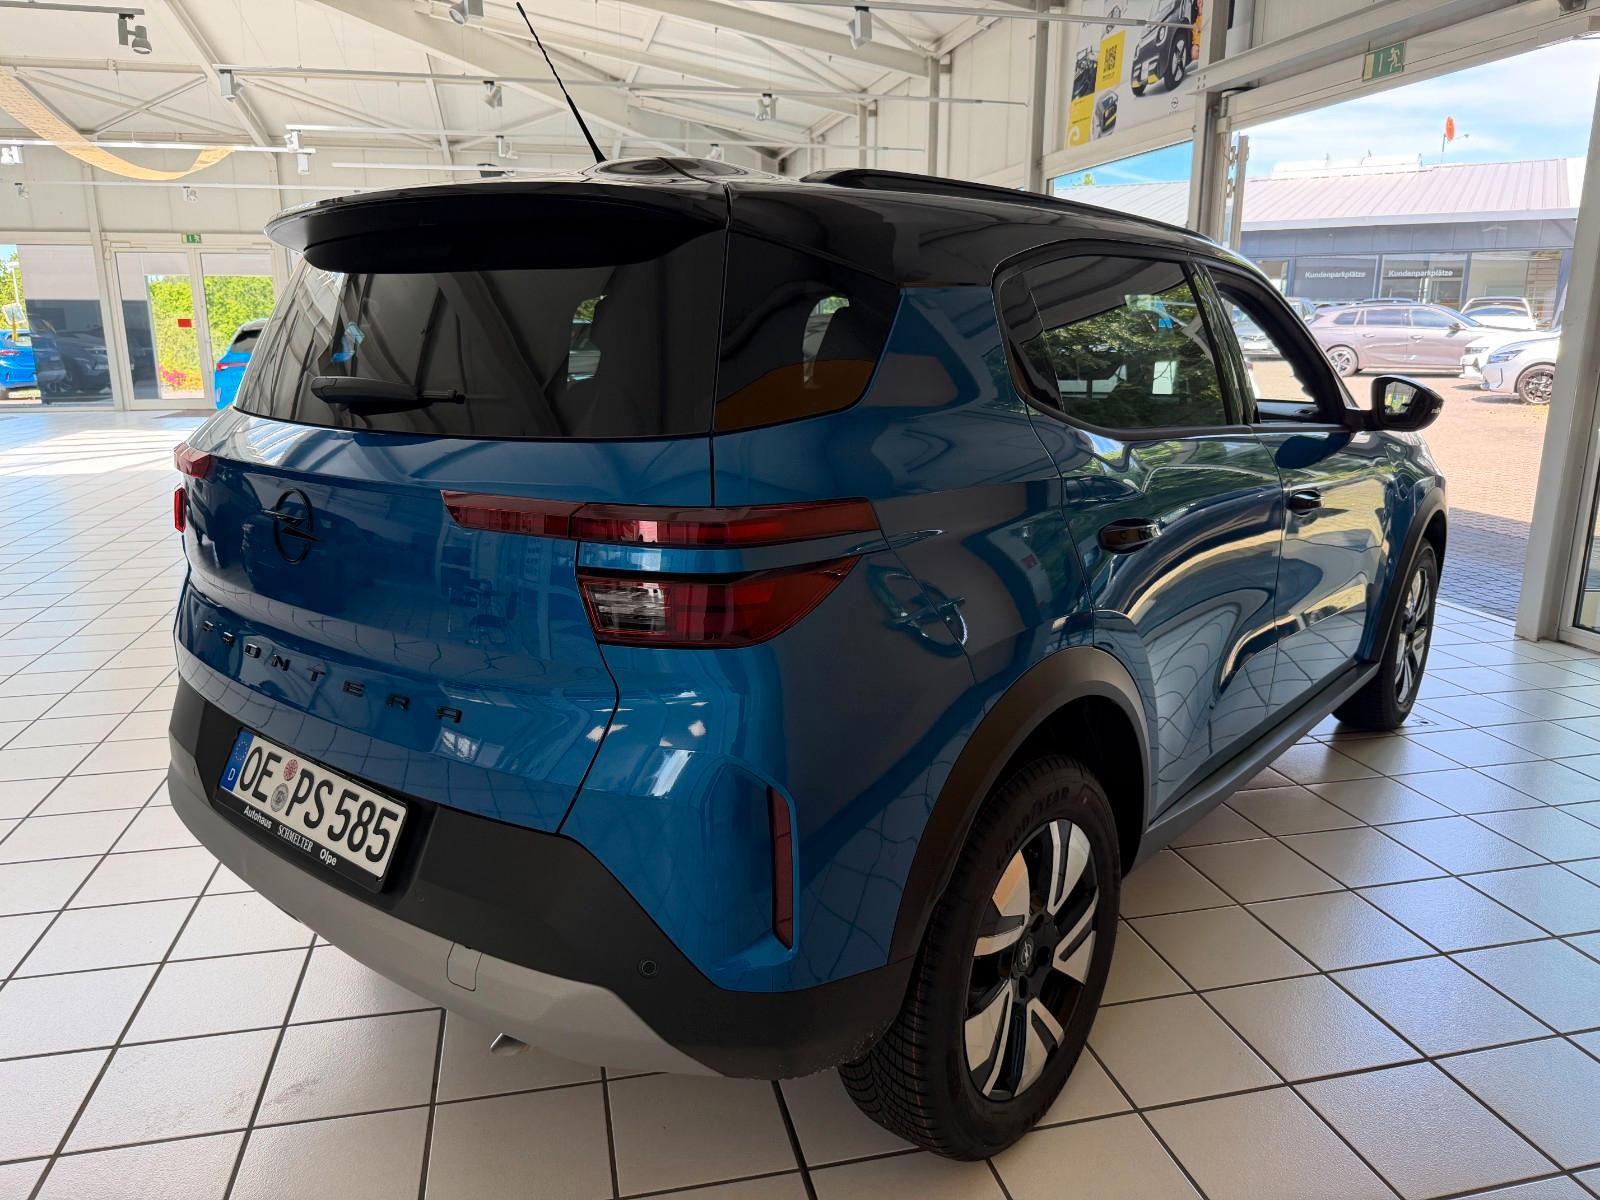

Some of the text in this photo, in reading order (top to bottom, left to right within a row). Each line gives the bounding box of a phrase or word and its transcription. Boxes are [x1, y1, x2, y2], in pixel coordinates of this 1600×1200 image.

[1304, 270, 1367, 279] Kundenparkplätze
[1387, 268, 1454, 278] Kundenparkplätze
[202, 620, 463, 724] FRONTERA
[228, 768, 236, 781] D
[240, 746, 399, 863] OE PS 585
[243, 806, 337, 866] Autohaus SCHMELTER Olpe
